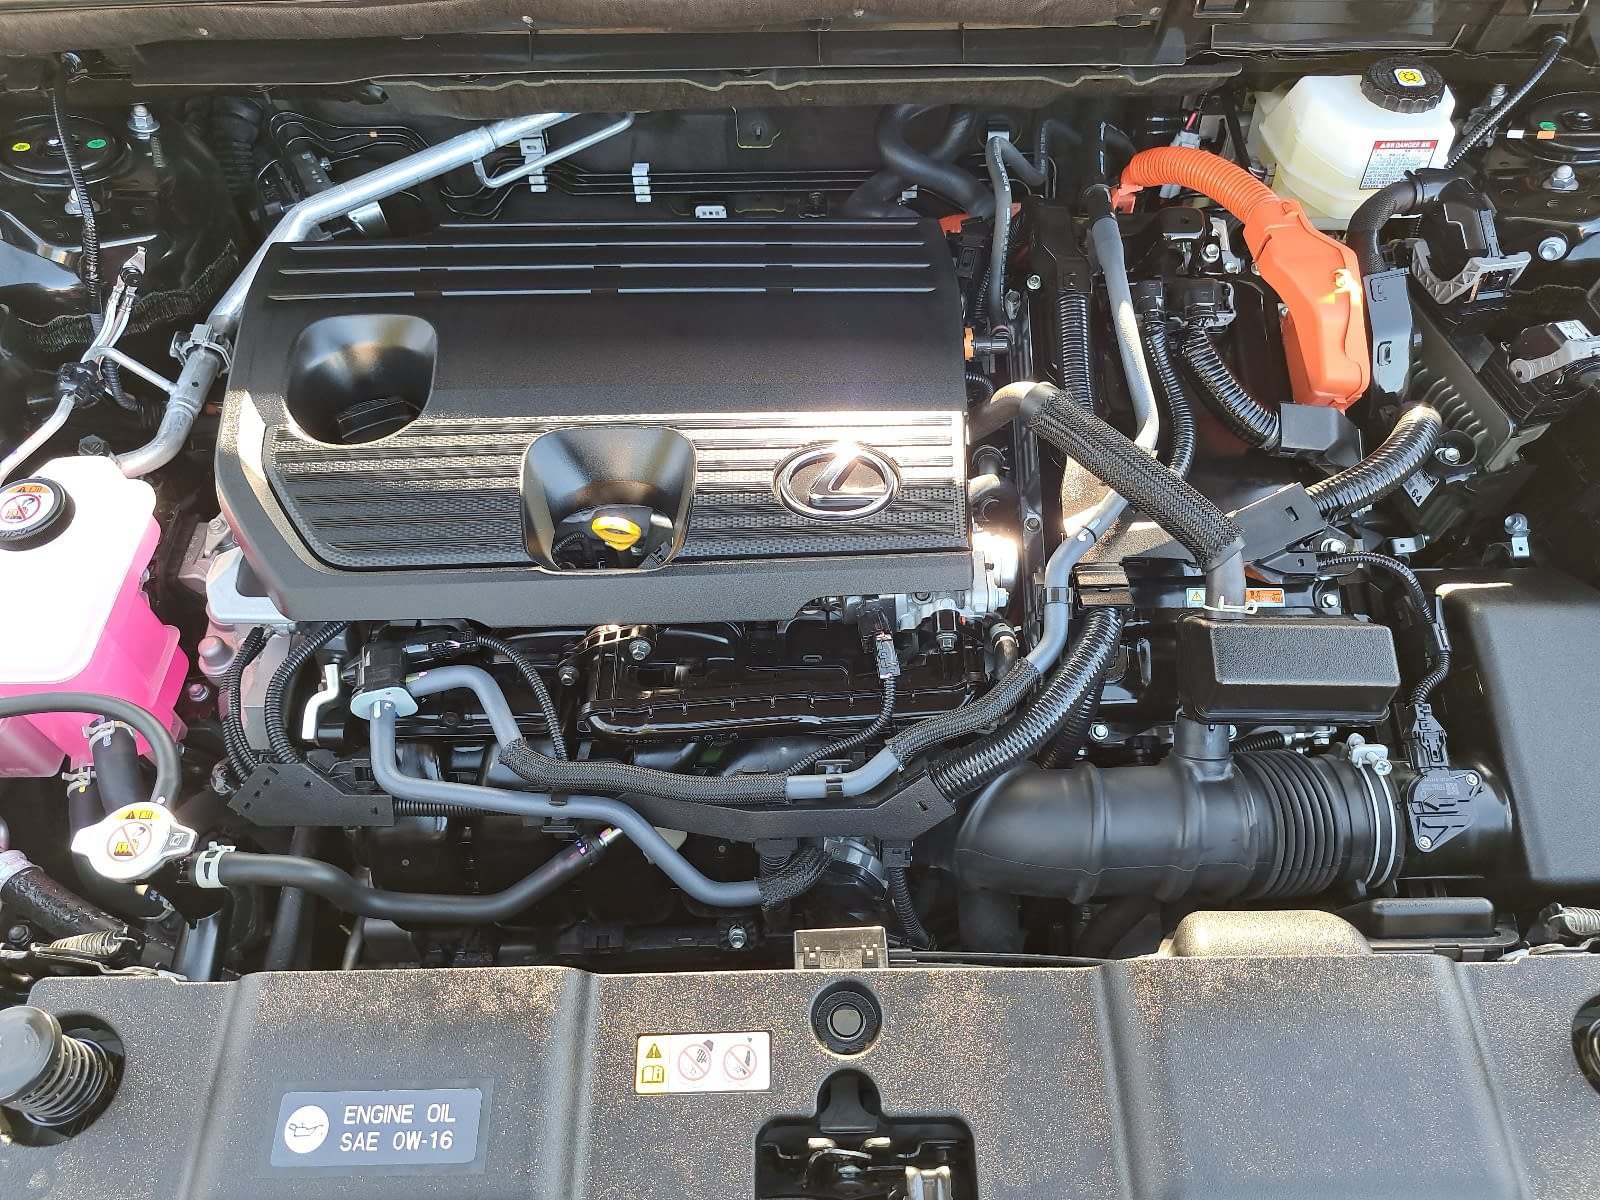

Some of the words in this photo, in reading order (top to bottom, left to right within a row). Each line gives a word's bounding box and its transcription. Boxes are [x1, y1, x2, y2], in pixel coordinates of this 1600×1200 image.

[343, 1103, 415, 1125] ENGINE
[426, 1103, 456, 1123] OIL
[339, 1131, 381, 1152] SAE
[392, 1130, 453, 1151] 0W-16
